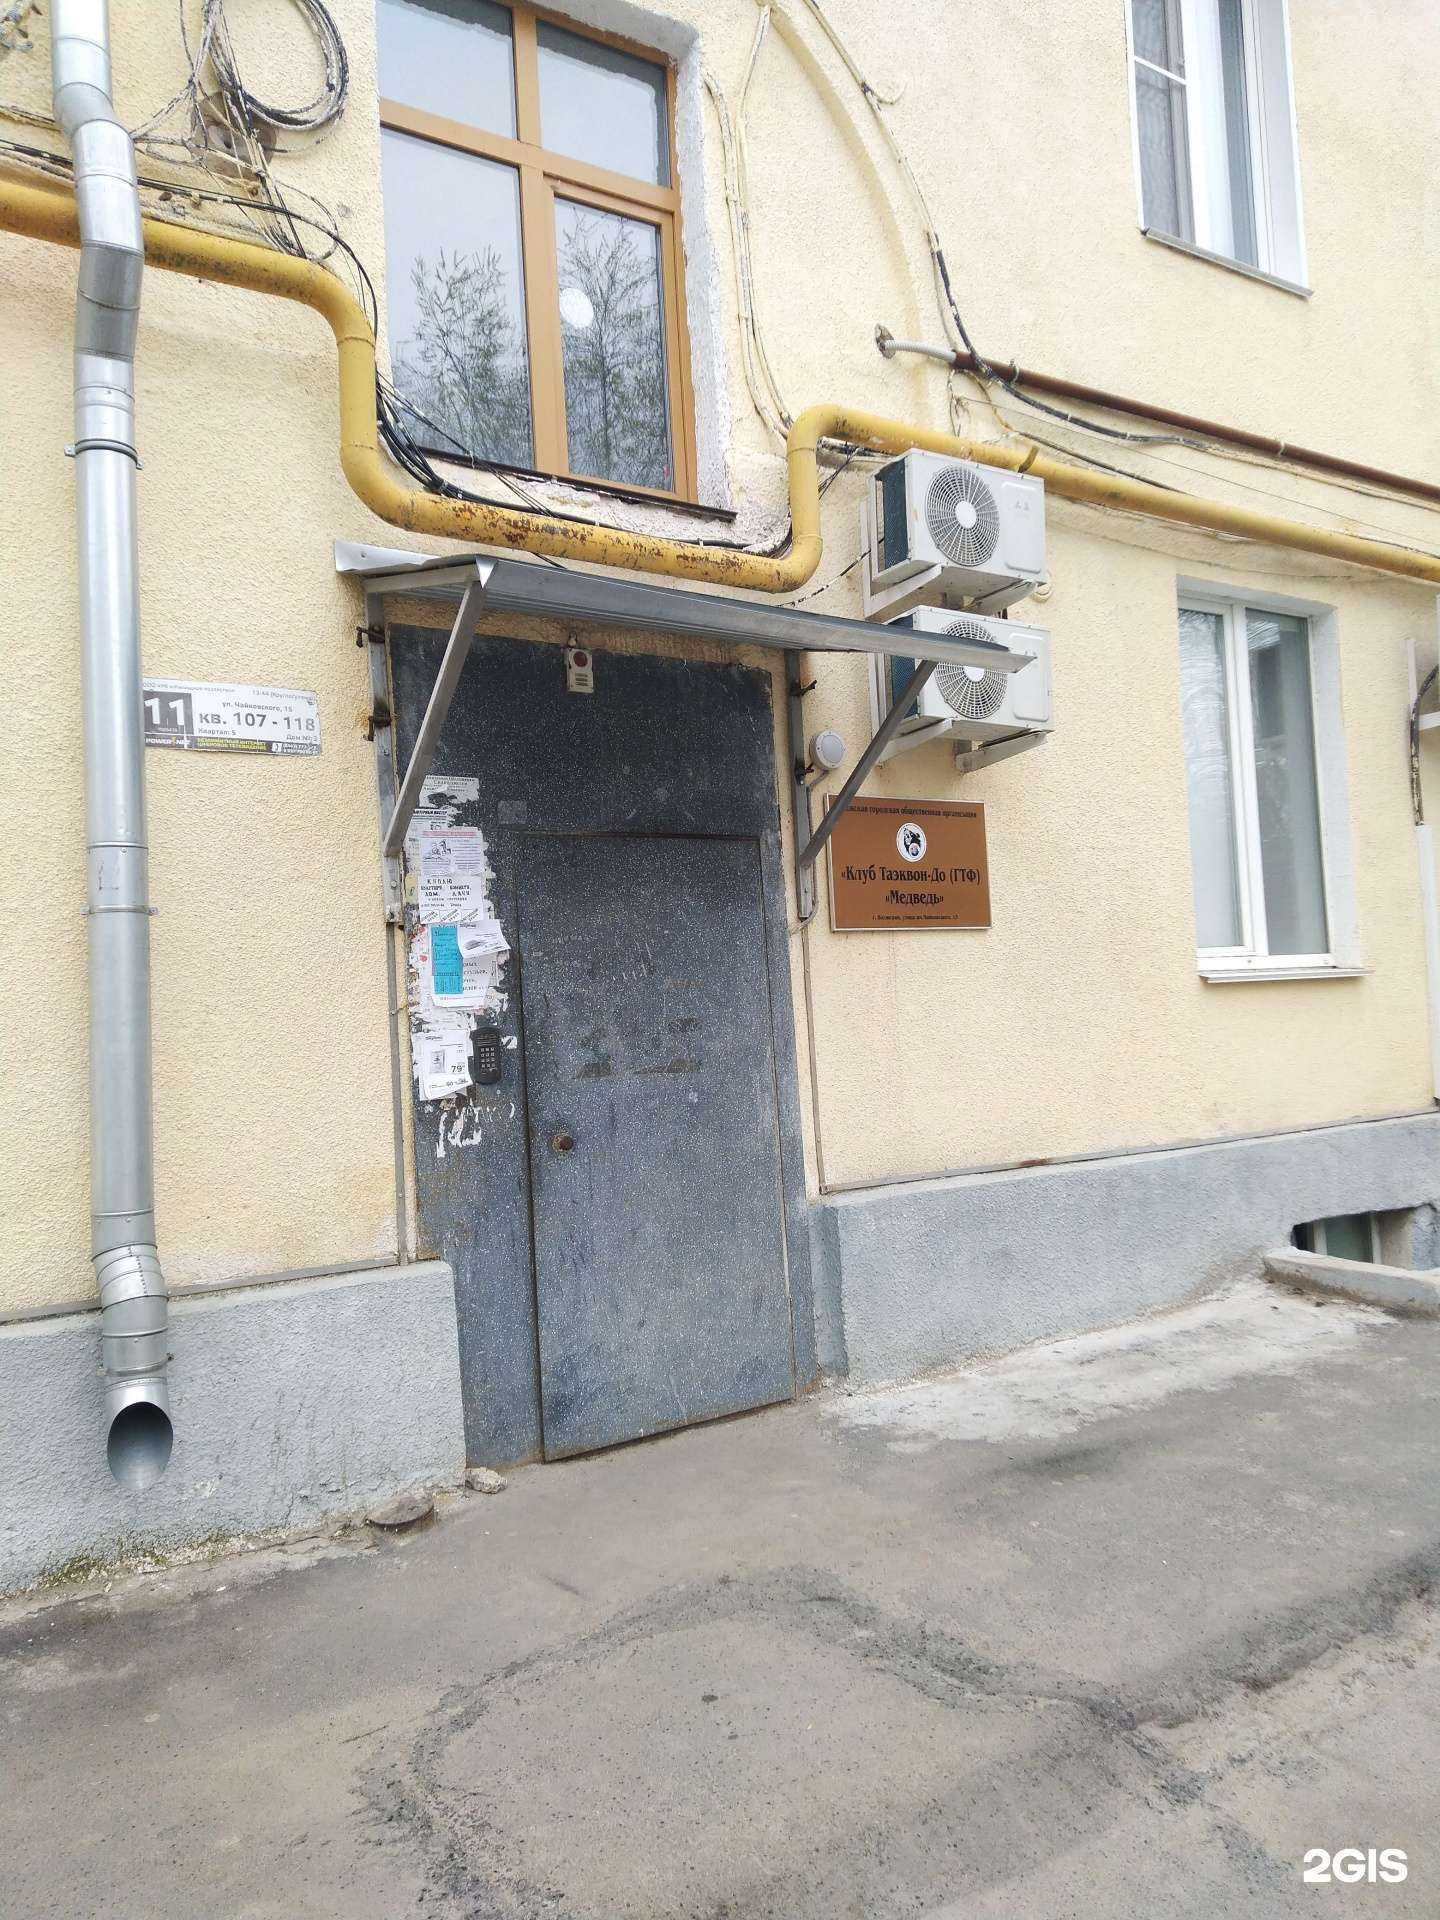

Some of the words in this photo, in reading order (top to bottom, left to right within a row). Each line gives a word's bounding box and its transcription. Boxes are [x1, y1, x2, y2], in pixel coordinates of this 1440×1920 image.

[144, 697, 185, 726] 11
[233, 712, 267, 727] 107
[283, 717, 316, 731] 118
[949, 868, 981, 886] (ГТФ)
[885, 889, 944, 907] «Медведь»
